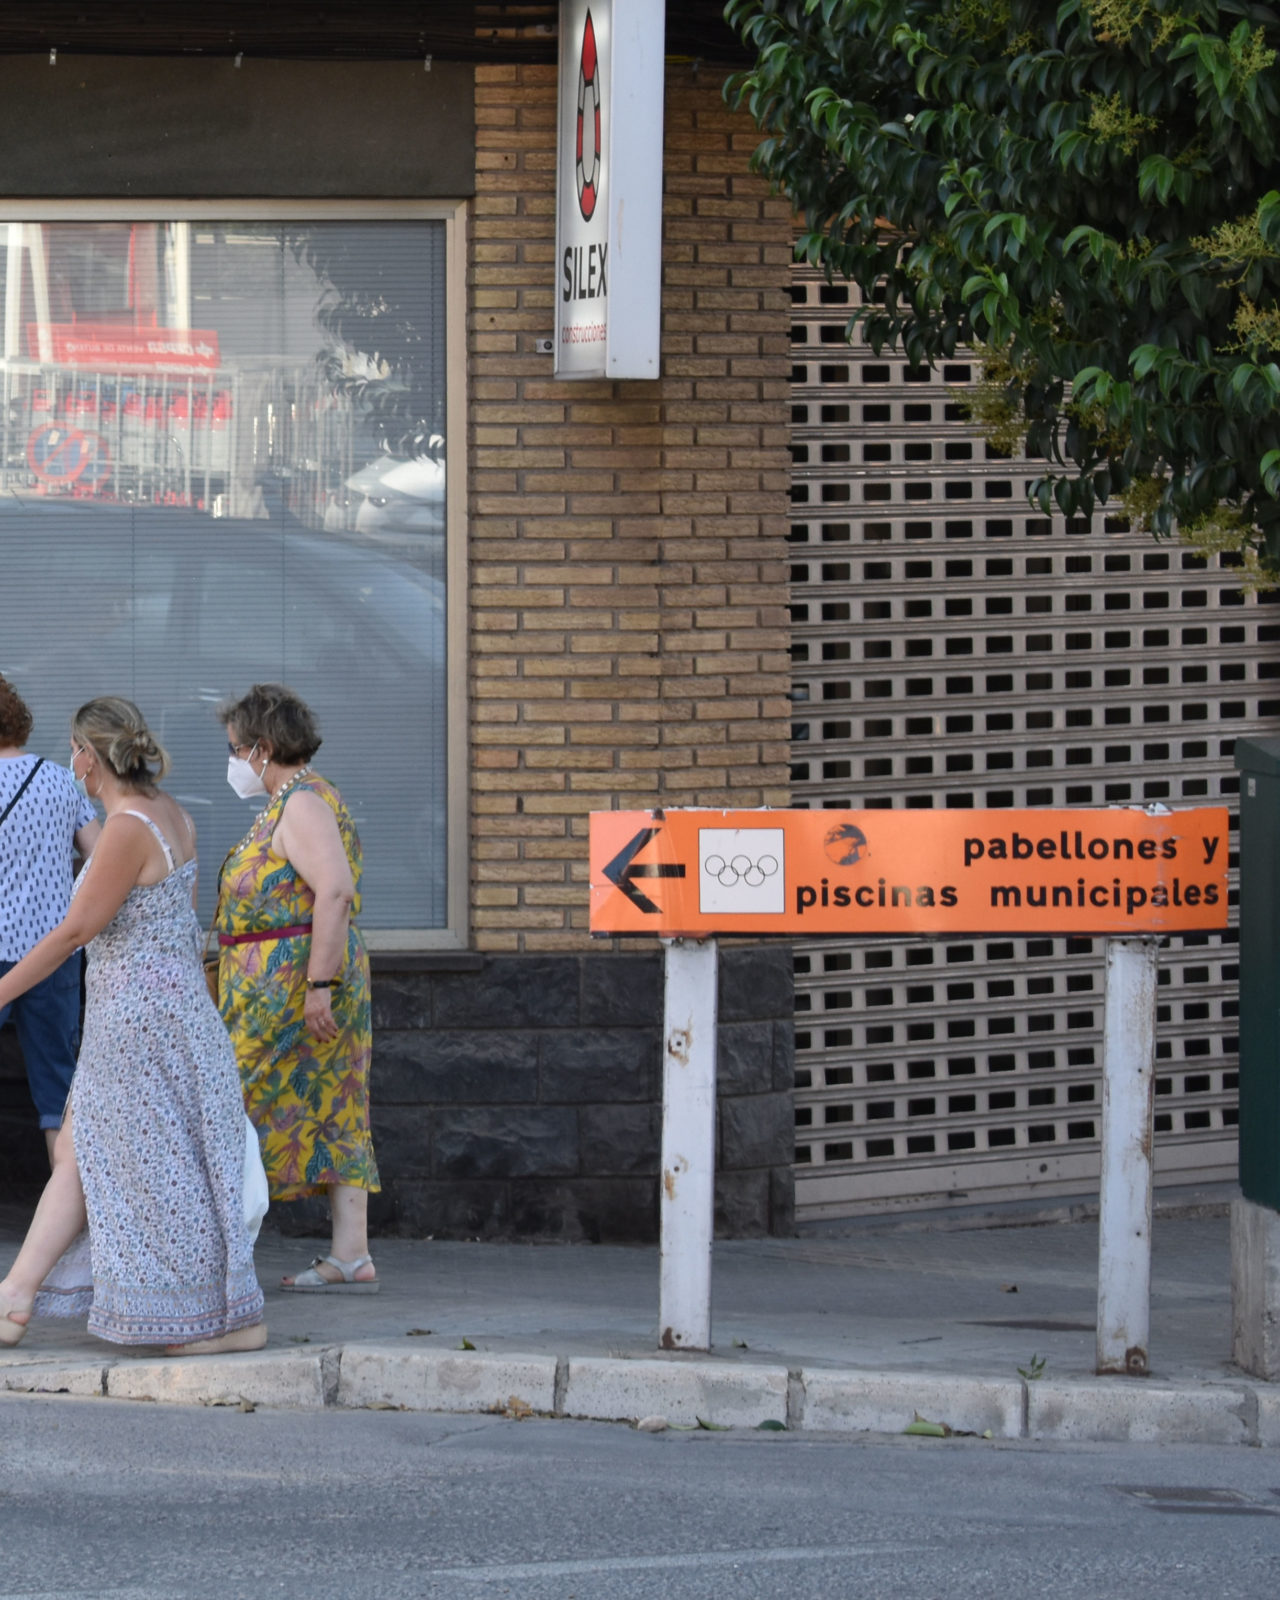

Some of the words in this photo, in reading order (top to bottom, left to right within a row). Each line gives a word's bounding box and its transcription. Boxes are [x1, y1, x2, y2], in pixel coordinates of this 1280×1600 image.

[563, 242, 608, 302] SILEX
[964, 830, 1177, 867] pabellones
[1202, 836, 1219, 864] y
[796, 878, 958, 914] piscinas
[990, 878, 1219, 914] municipales
